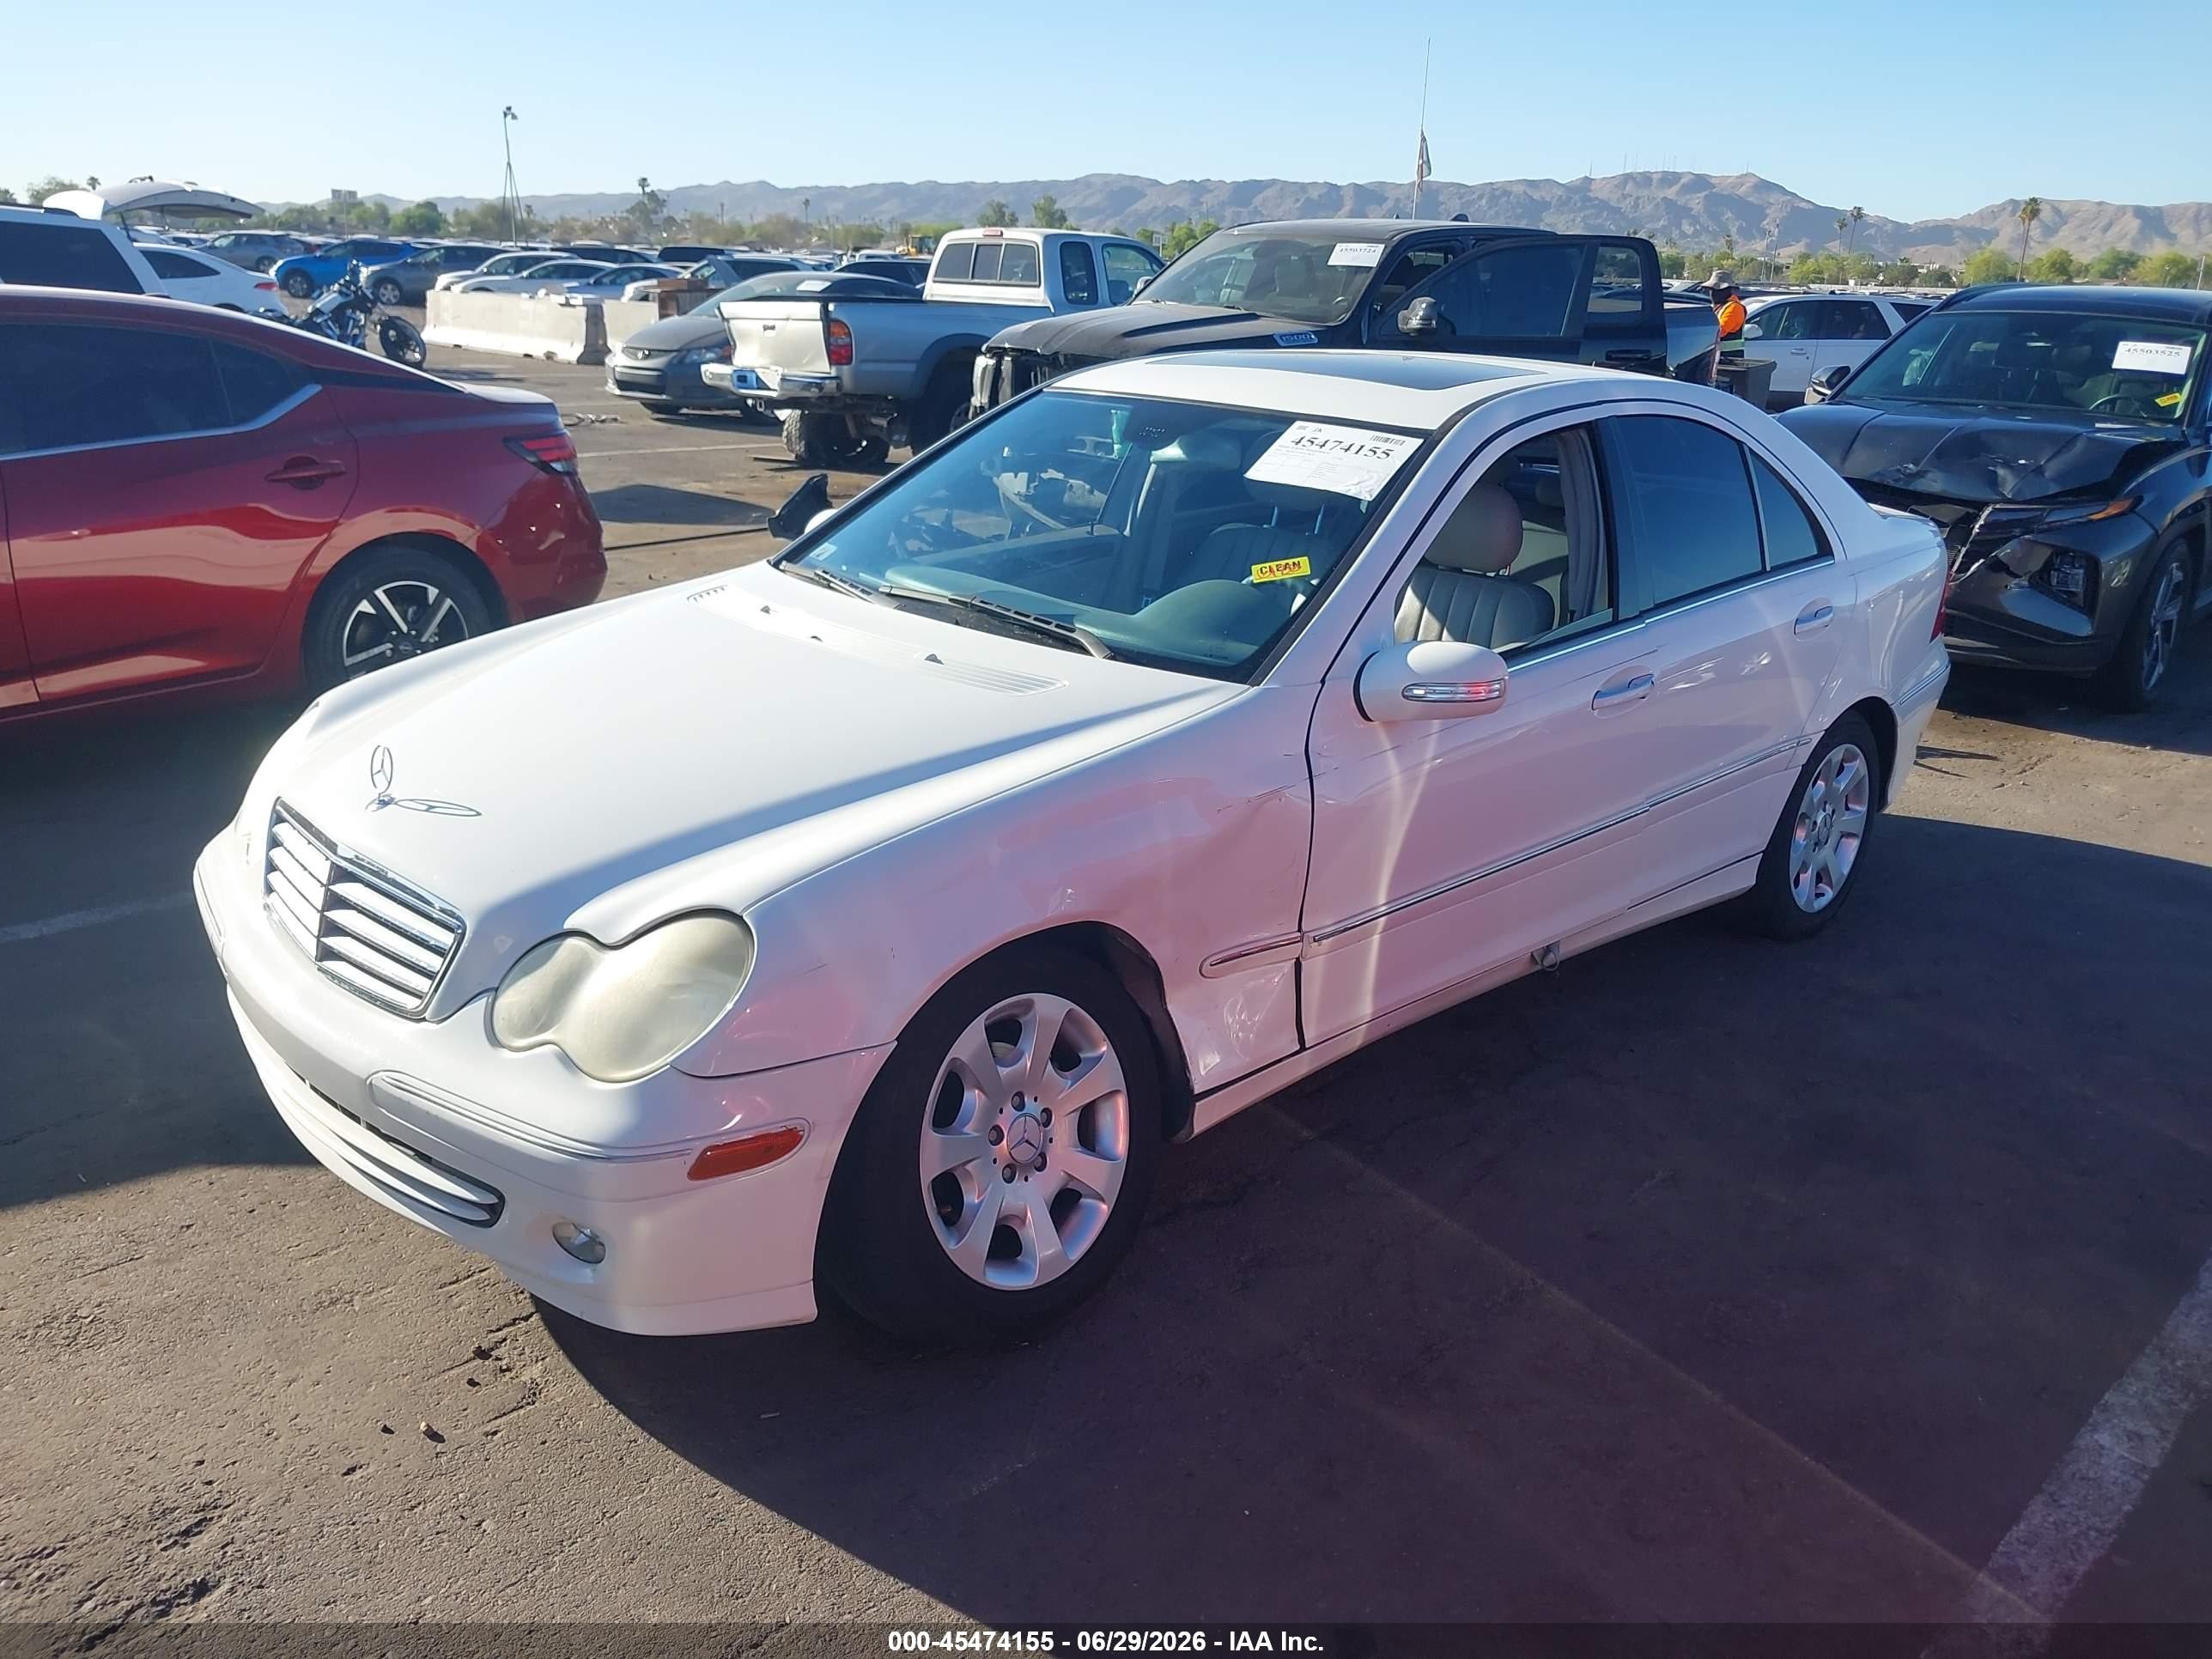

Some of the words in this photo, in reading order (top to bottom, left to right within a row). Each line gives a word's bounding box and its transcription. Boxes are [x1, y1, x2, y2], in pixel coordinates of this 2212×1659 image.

[2124, 348, 2181, 357] 45503525
[1291, 435, 1395, 460] 45474155
[1259, 560, 1301, 574] CLEAN
